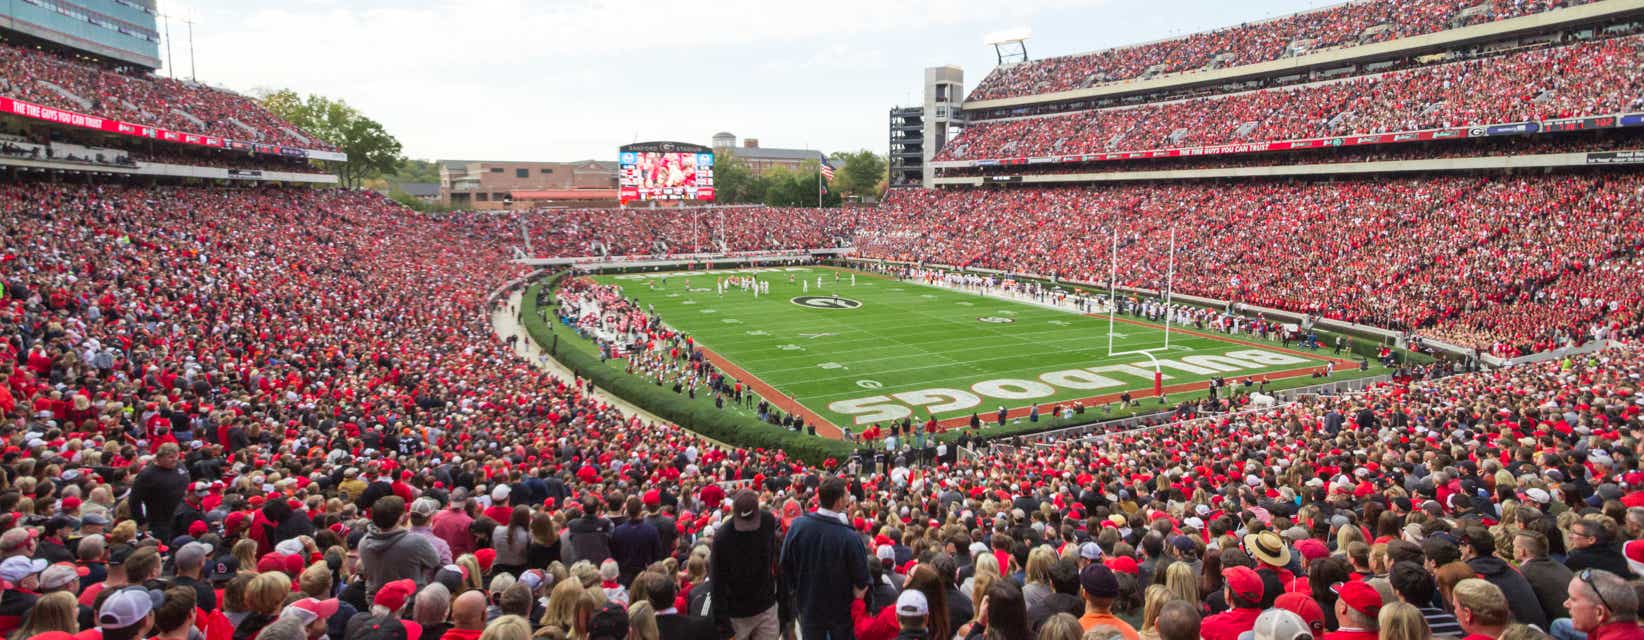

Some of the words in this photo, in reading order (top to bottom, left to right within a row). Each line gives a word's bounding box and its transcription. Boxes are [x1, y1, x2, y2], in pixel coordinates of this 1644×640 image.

[13, 101, 26, 114] THE
[26, 104, 41, 117] TIRE
[41, 108, 58, 121] GUYS
[58, 111, 71, 123] YOU
[72, 114, 84, 125] CAN
[85, 117, 102, 128] TRUST
[1204, 146, 1220, 154] GUYS
[1221, 145, 1234, 153] YOU
[1235, 144, 1249, 152] CAN
[1250, 142, 1269, 151] TRUST
[828, 350, 1311, 425] BULLDOGS
